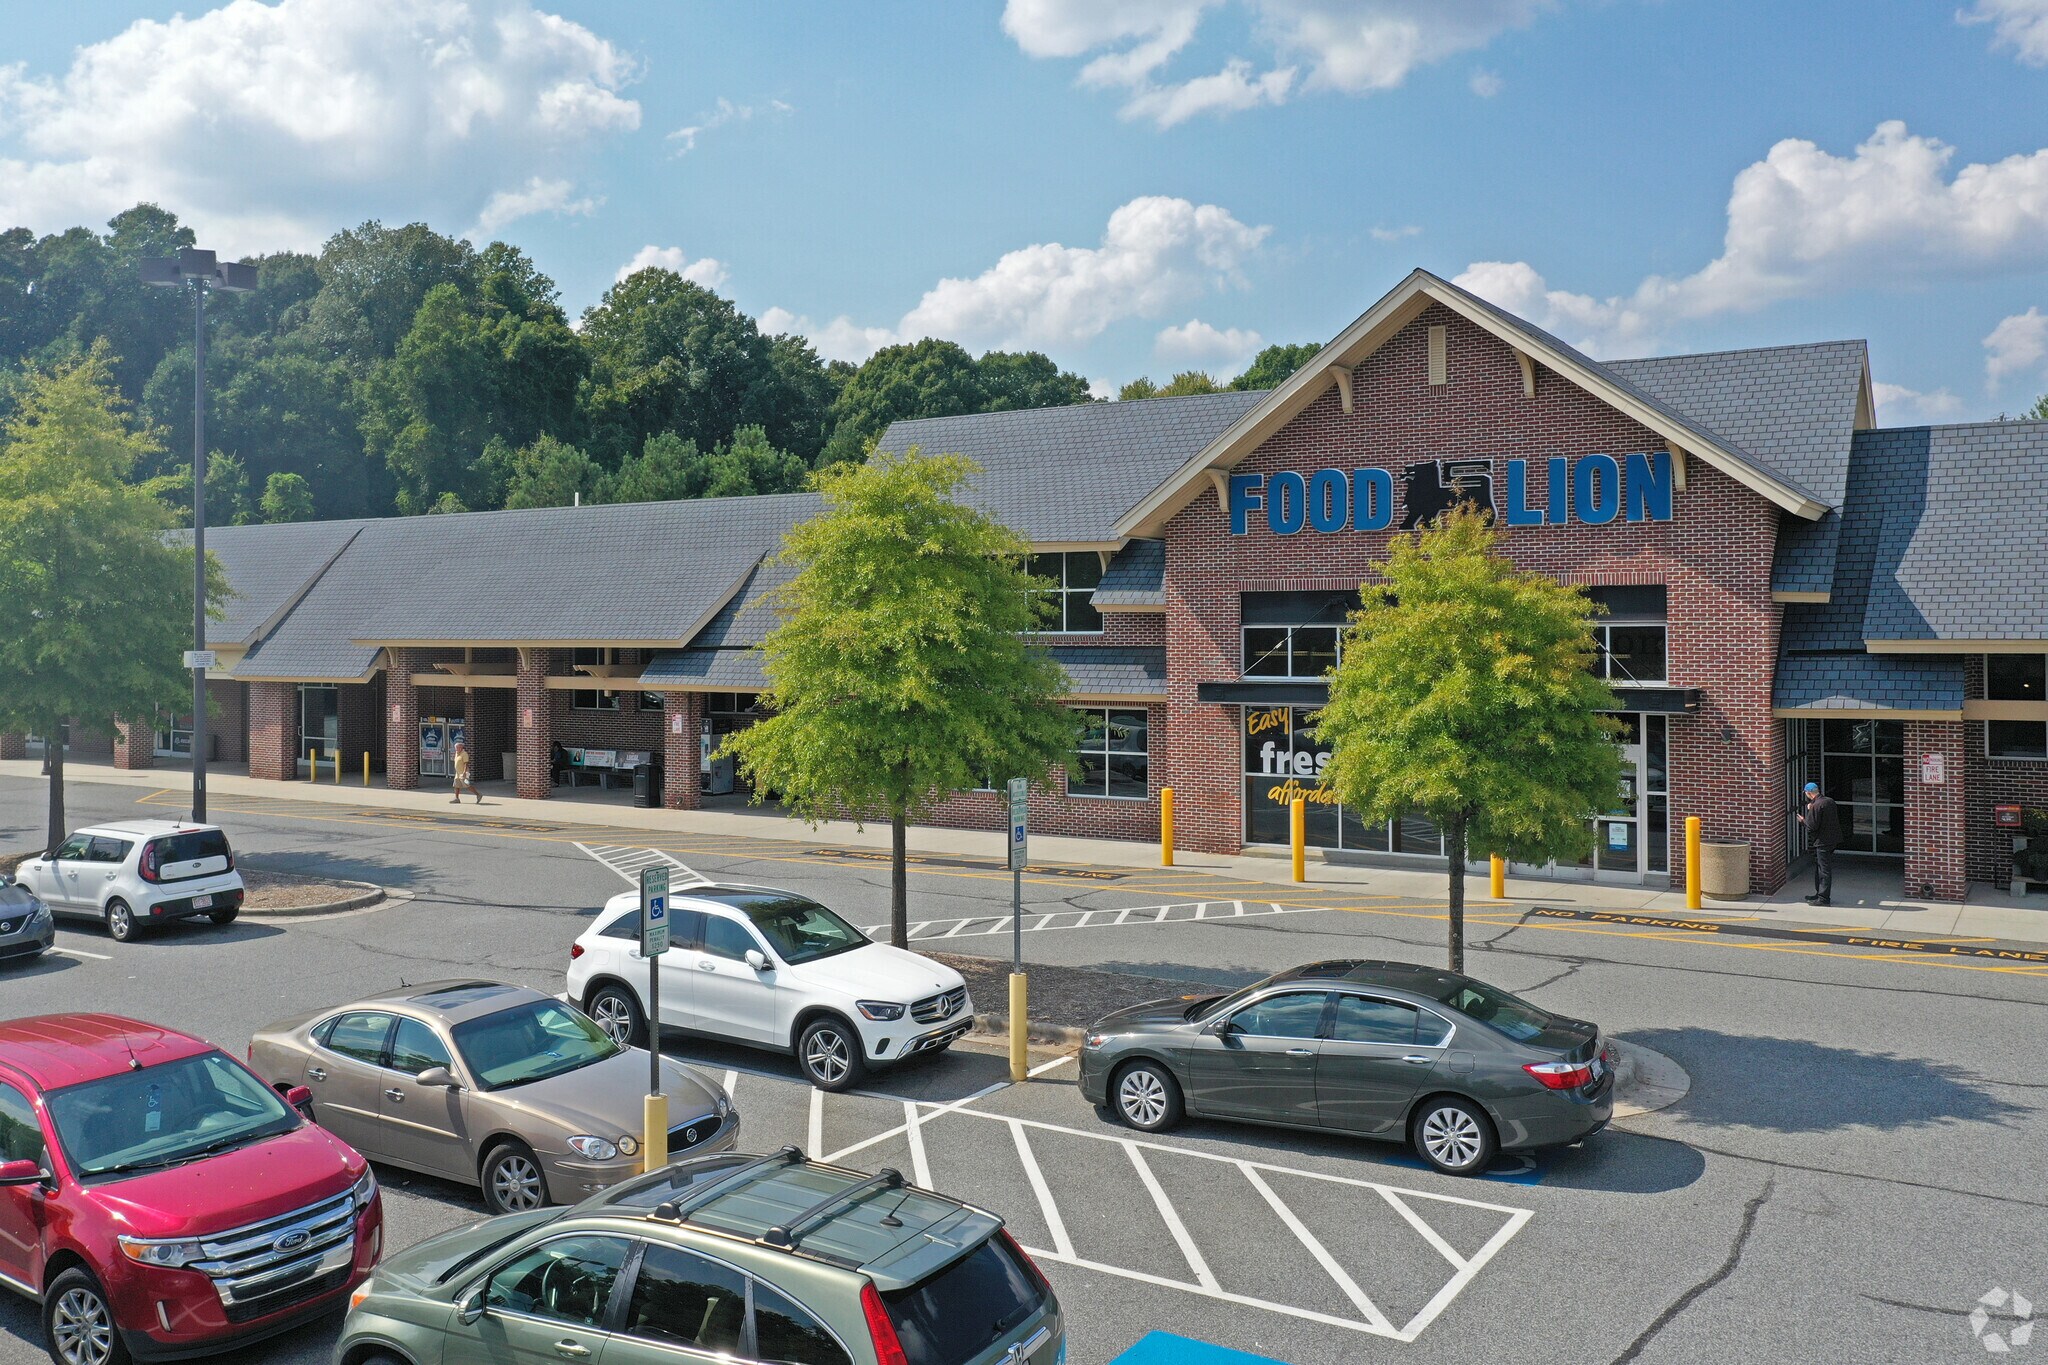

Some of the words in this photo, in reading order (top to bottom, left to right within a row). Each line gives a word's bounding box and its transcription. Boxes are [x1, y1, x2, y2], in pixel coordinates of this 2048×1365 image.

[1231, 468, 1394, 536] FOOD
[1507, 451, 1673, 527] LION
[1247, 707, 1289, 735] Easy
[1260, 741, 1335, 775] fres
[646, 872, 668, 885] RESERVED
[648, 883, 666, 894] PARKING
[1535, 909, 1575, 917] NO
[1591, 914, 1720, 931] PARKING
[1848, 938, 1925, 950] FIRE
[1950, 947, 2047, 960] LANE
